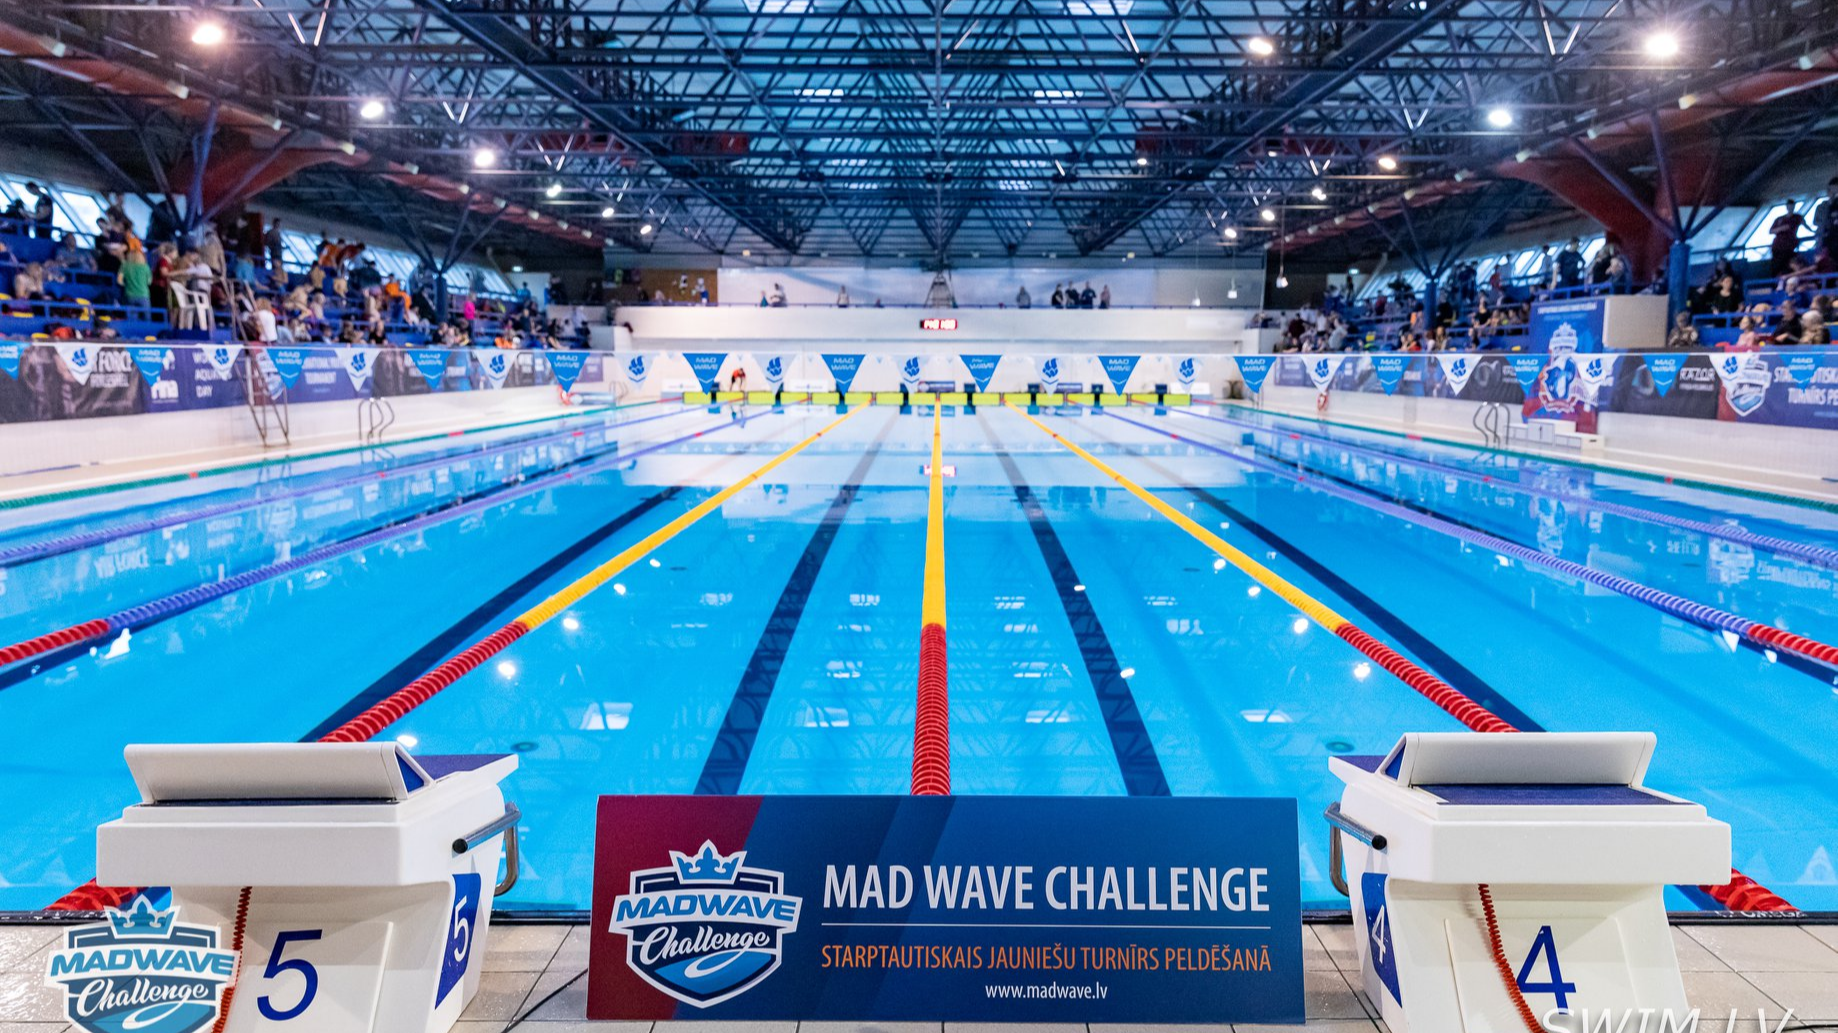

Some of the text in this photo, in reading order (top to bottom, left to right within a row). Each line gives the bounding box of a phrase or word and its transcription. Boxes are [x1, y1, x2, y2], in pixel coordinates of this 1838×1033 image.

[616, 894, 797, 922] MADWAVE
[823, 865, 1269, 912] MAD WAVE CHALLENGE
[453, 895, 469, 961] 5
[639, 925, 770, 965] Challenge
[1371, 904, 1386, 965] 4
[256, 929, 323, 1021] 5
[821, 943, 1271, 971] STARPTAUTISKAIS JAUNIEŠU TURNĪRS PELDĒŠANĀ
[1516, 925, 1577, 1015] 4
[985, 981, 1108, 999] www.madwave.lv
